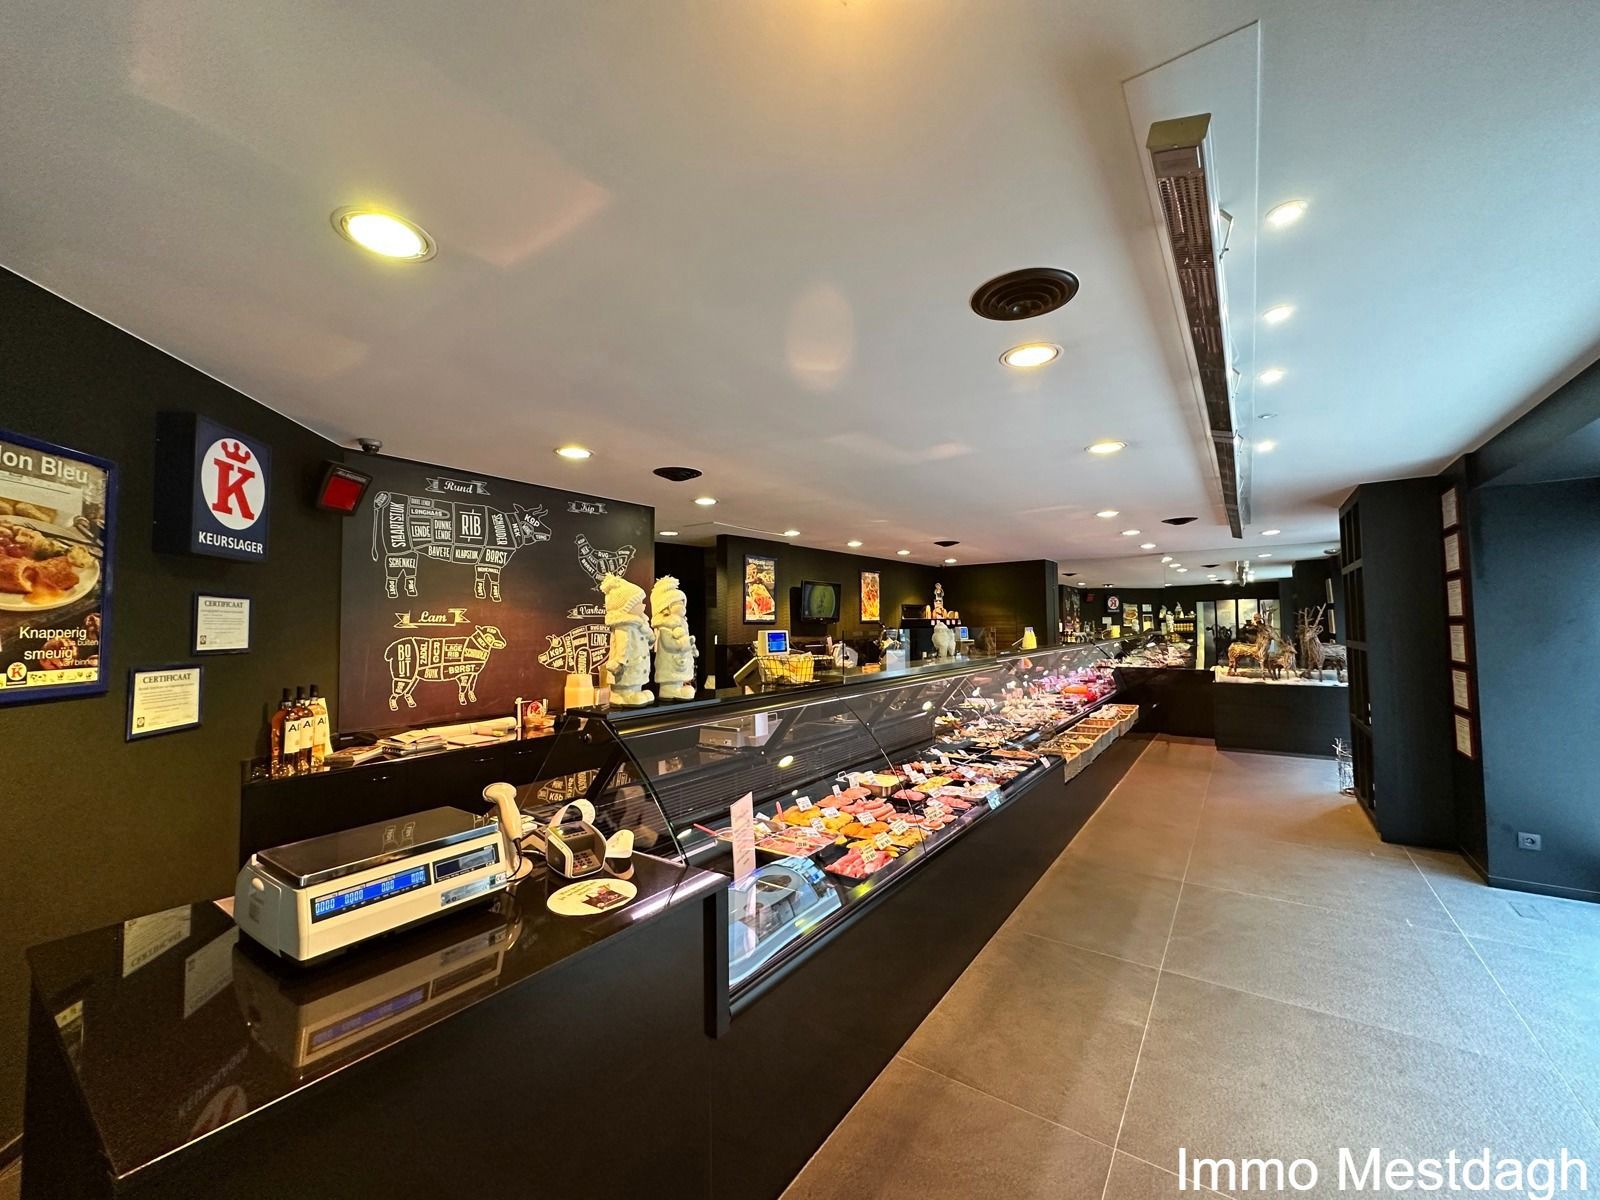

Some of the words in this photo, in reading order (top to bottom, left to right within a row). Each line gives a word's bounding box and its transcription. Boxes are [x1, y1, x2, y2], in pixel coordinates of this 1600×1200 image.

[0, 445, 33, 471] on
[41, 456, 88, 484] Bleu
[212, 458, 255, 520] K
[444, 481, 473, 494] Rund
[390, 501, 406, 548] STAARTSTUK
[461, 514, 481, 536] RIB
[524, 514, 540, 527] KOP
[411, 525, 431, 538] LENDE
[435, 530, 452, 540] LENDE
[491, 513, 508, 545] SCHOUDER
[198, 531, 264, 554] KEURSLAGER
[388, 557, 416, 568] SCHENKEL
[485, 548, 508, 564] BORST
[204, 600, 243, 608] CERTIFICAAT
[418, 611, 447, 622] Lam
[20, 626, 87, 641] Knapperig
[24, 647, 73, 659] smeuïg
[420, 642, 428, 664] ZADEL
[448, 664, 475, 674] BORST
[143, 673, 192, 684] CERTIFICAAT
